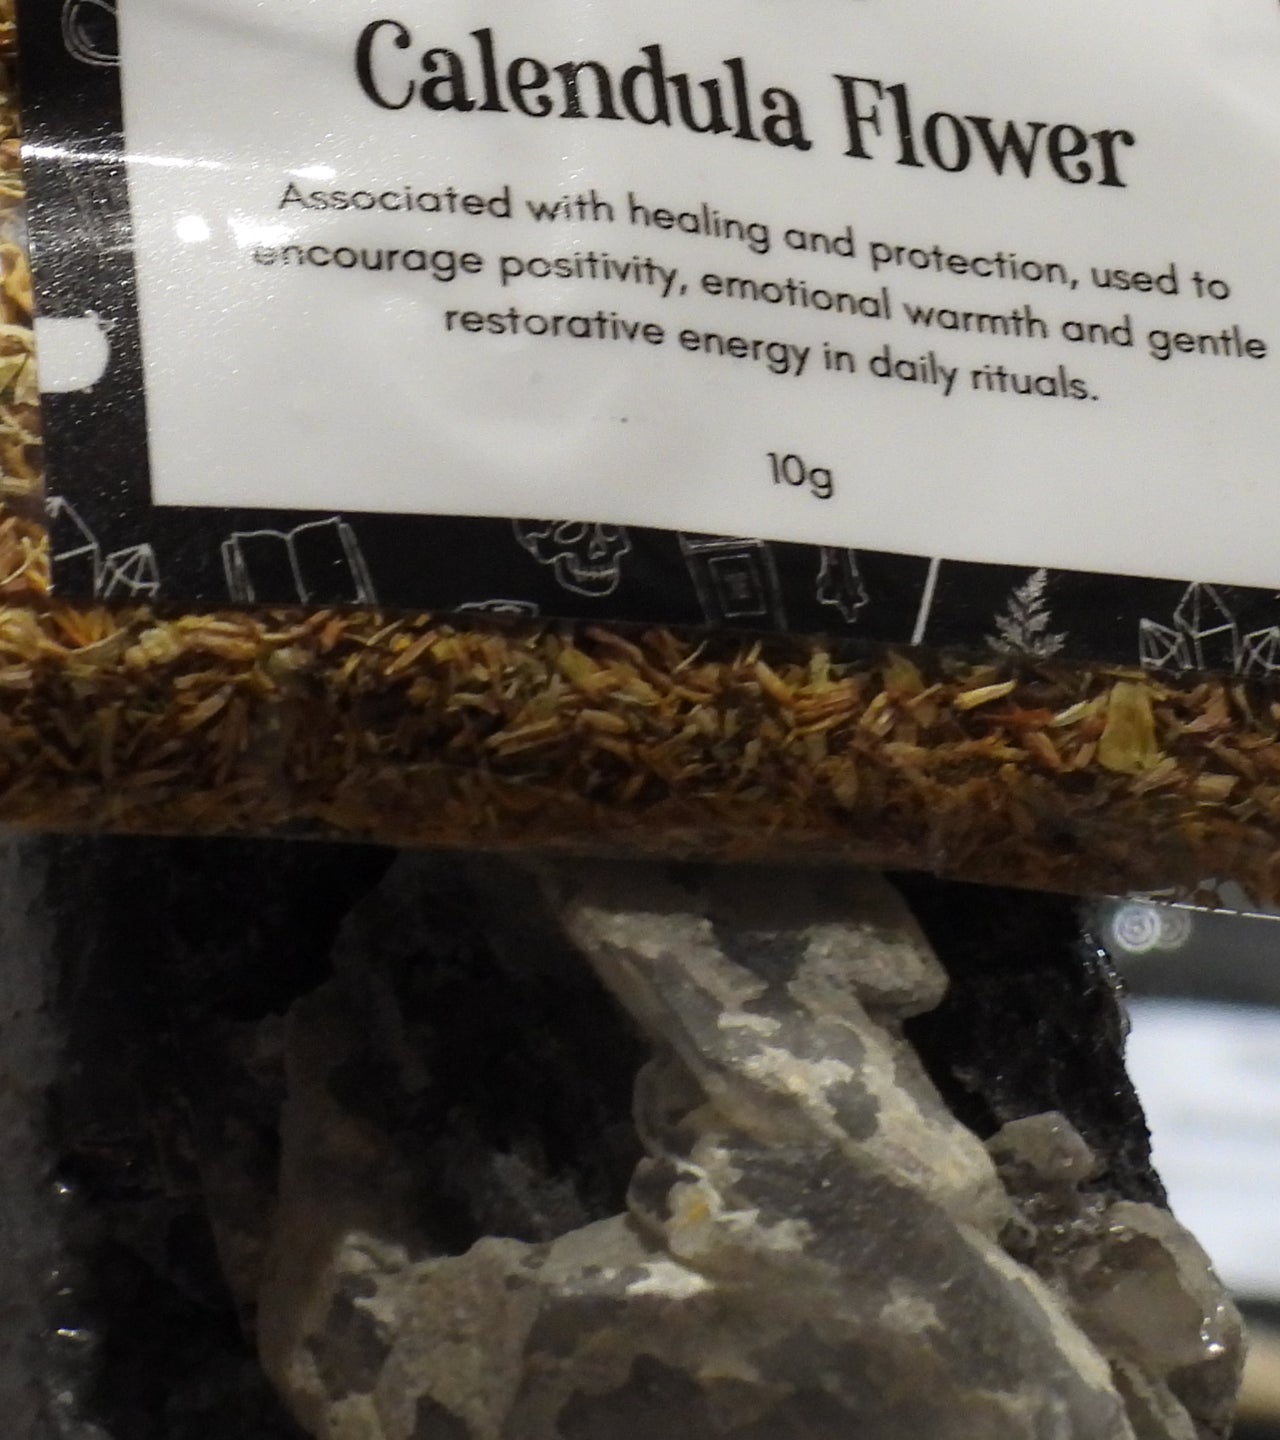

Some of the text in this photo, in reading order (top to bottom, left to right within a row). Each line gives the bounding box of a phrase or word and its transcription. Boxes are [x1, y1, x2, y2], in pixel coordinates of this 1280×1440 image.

[354, 17, 1135, 188] Calendula Flower
[278, 182, 1231, 301] Associated with healing and protection, used to
[254, 243, 1268, 361] encourage positivity, emotional warmth and gentle
[445, 306, 1099, 403] restorative energy in daily rituals.
[766, 452, 834, 499] 10g
